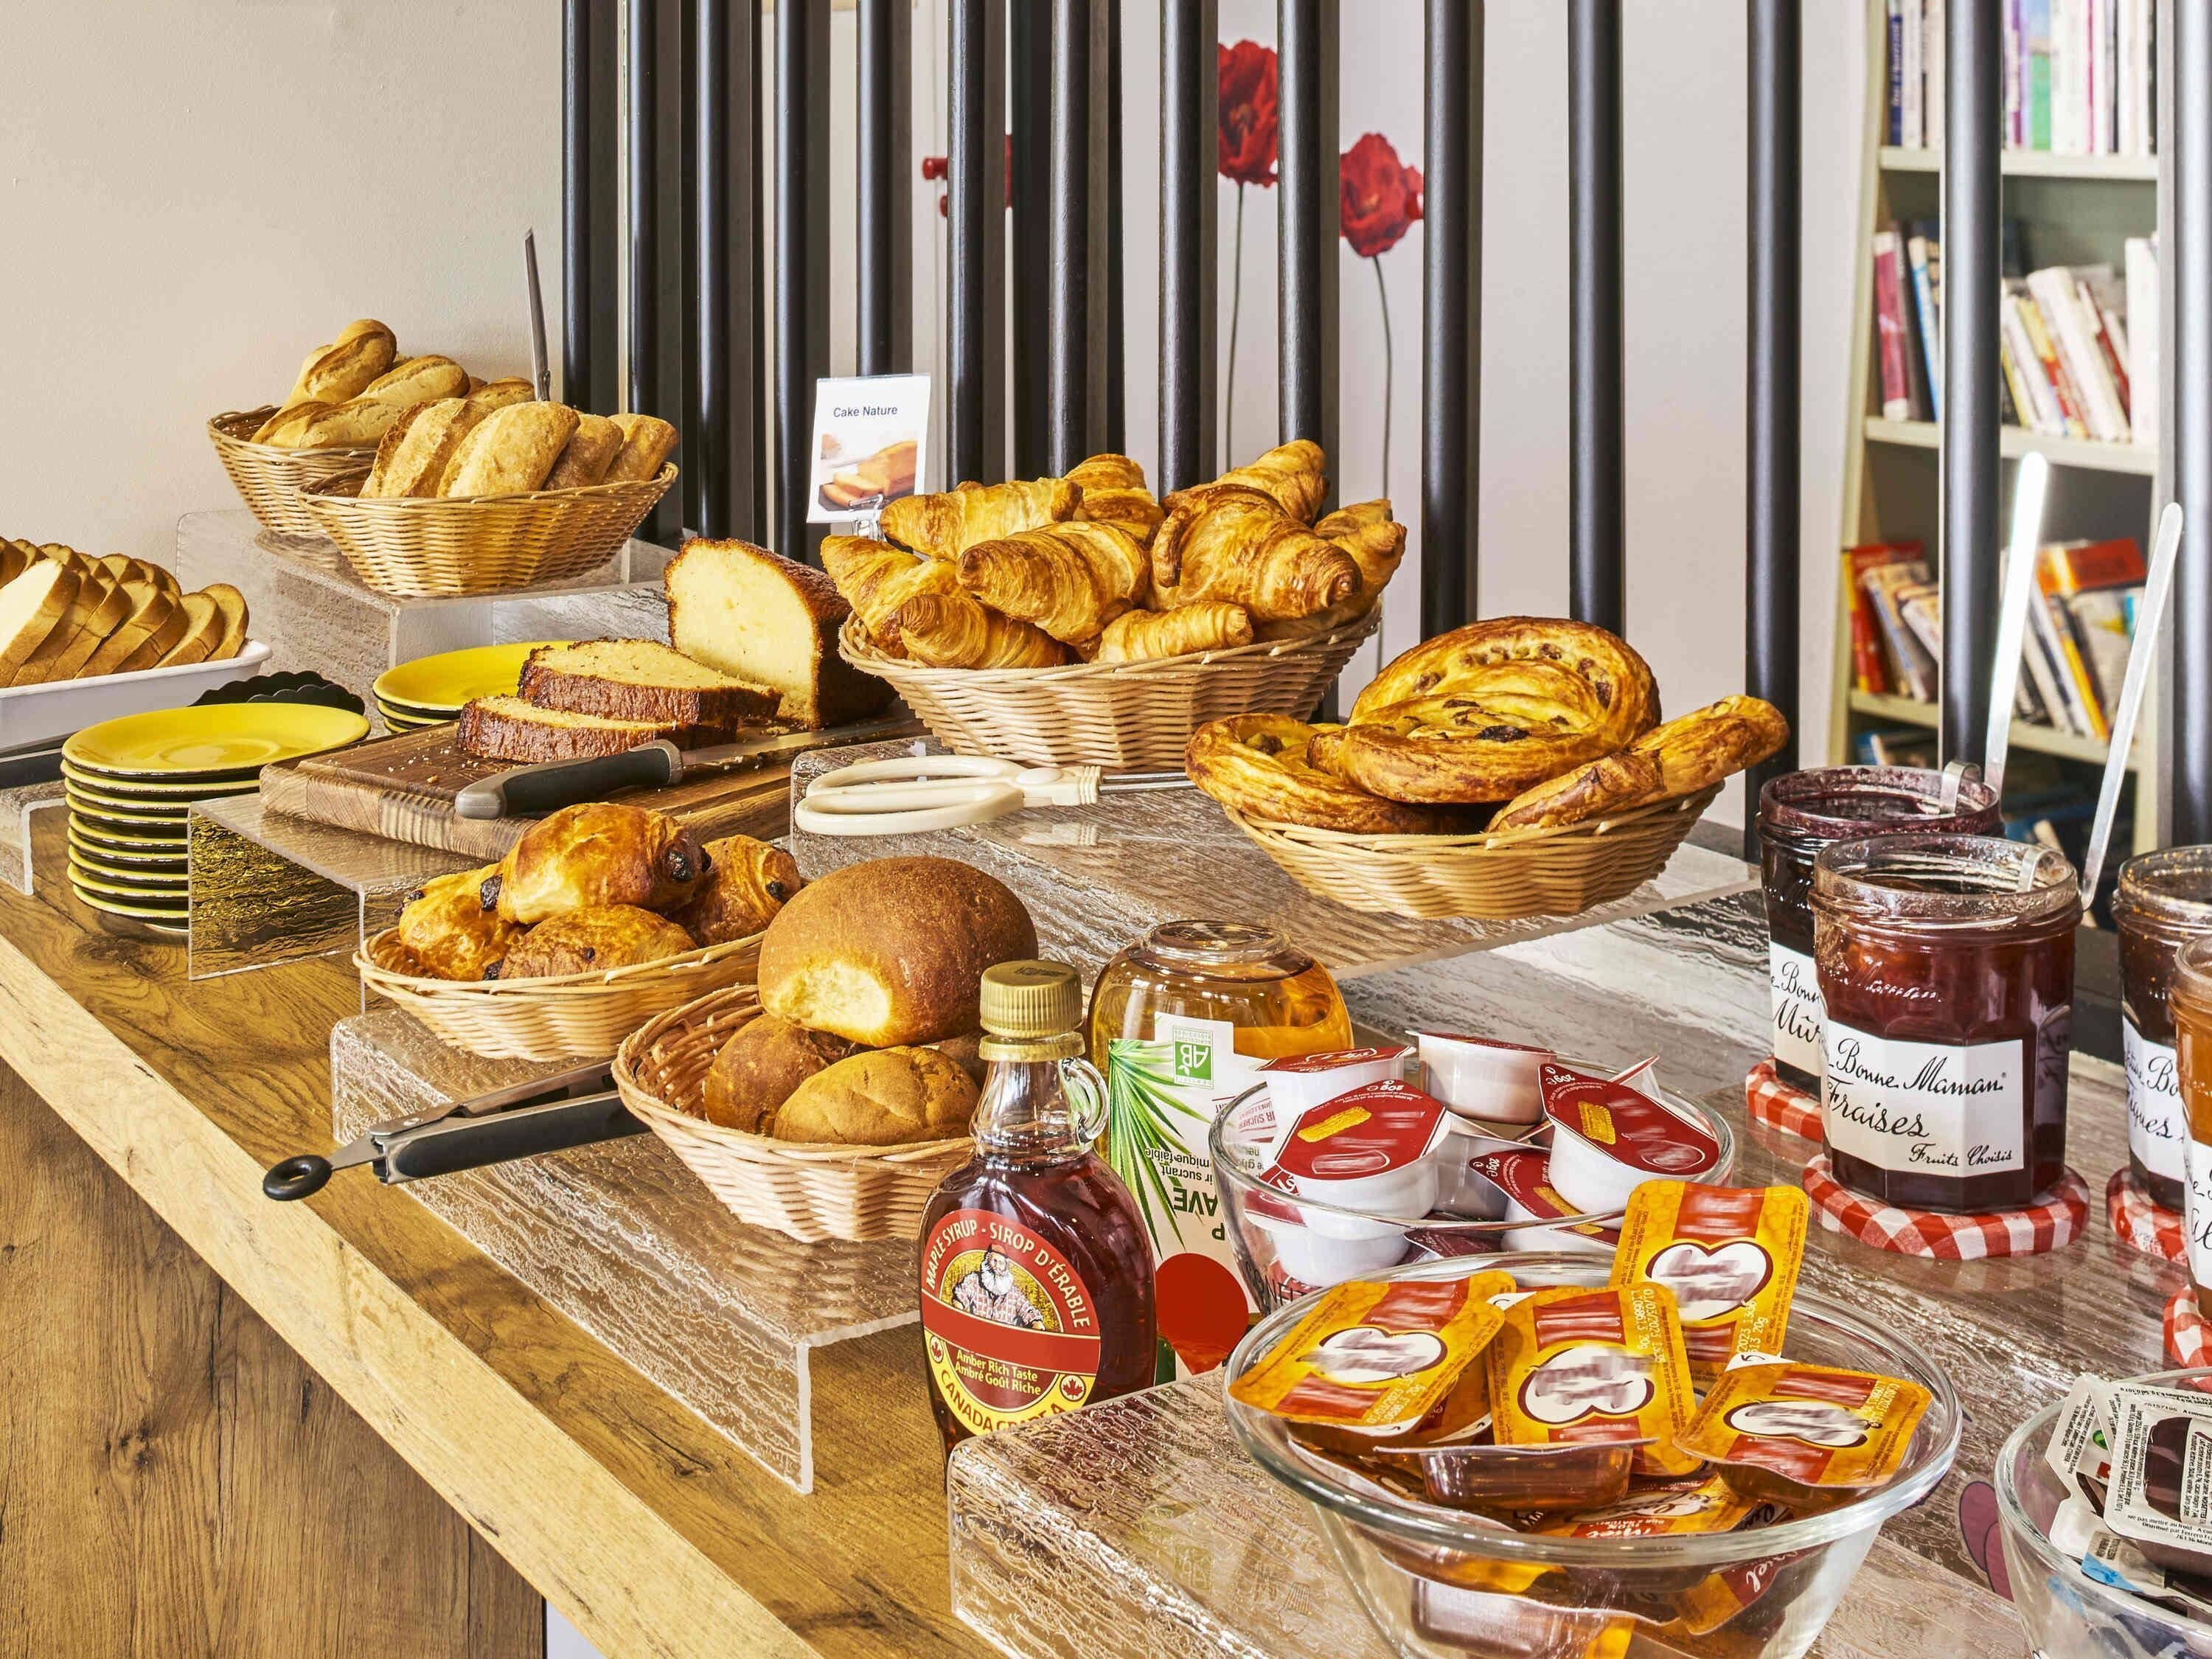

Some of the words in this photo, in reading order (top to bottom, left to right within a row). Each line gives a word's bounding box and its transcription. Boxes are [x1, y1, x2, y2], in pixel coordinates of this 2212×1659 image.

[833, 406, 860, 417] Cake
[863, 406, 897, 417] Nature
[1781, 961, 1820, 1003] Bonn
[1836, 1038, 1899, 1089] Bonne
[1903, 1056, 2003, 1096] Maman
[1827, 1075, 1930, 1138] Fraises
[1161, 1166, 1203, 1181] sucrant
[1908, 1143, 1959, 1167] Fruits
[1966, 1144, 2012, 1166] Choisis
[925, 1237, 946, 1290] MAPLE
[942, 1219, 978, 1247] SYRUP
[990, 1222, 1034, 1253] SIROP
[1034, 1248, 1091, 1328] D'ÉRABLE
[955, 1361, 984, 1382] Ambré
[985, 1373, 1009, 1389] Goût
[1012, 1380, 1042, 1396] Riche
[956, 1349, 986, 1369] Amber
[988, 1360, 1009, 1375] Rich
[1012, 1366, 1038, 1382] Taste
[941, 1369, 993, 1432] CANADA
